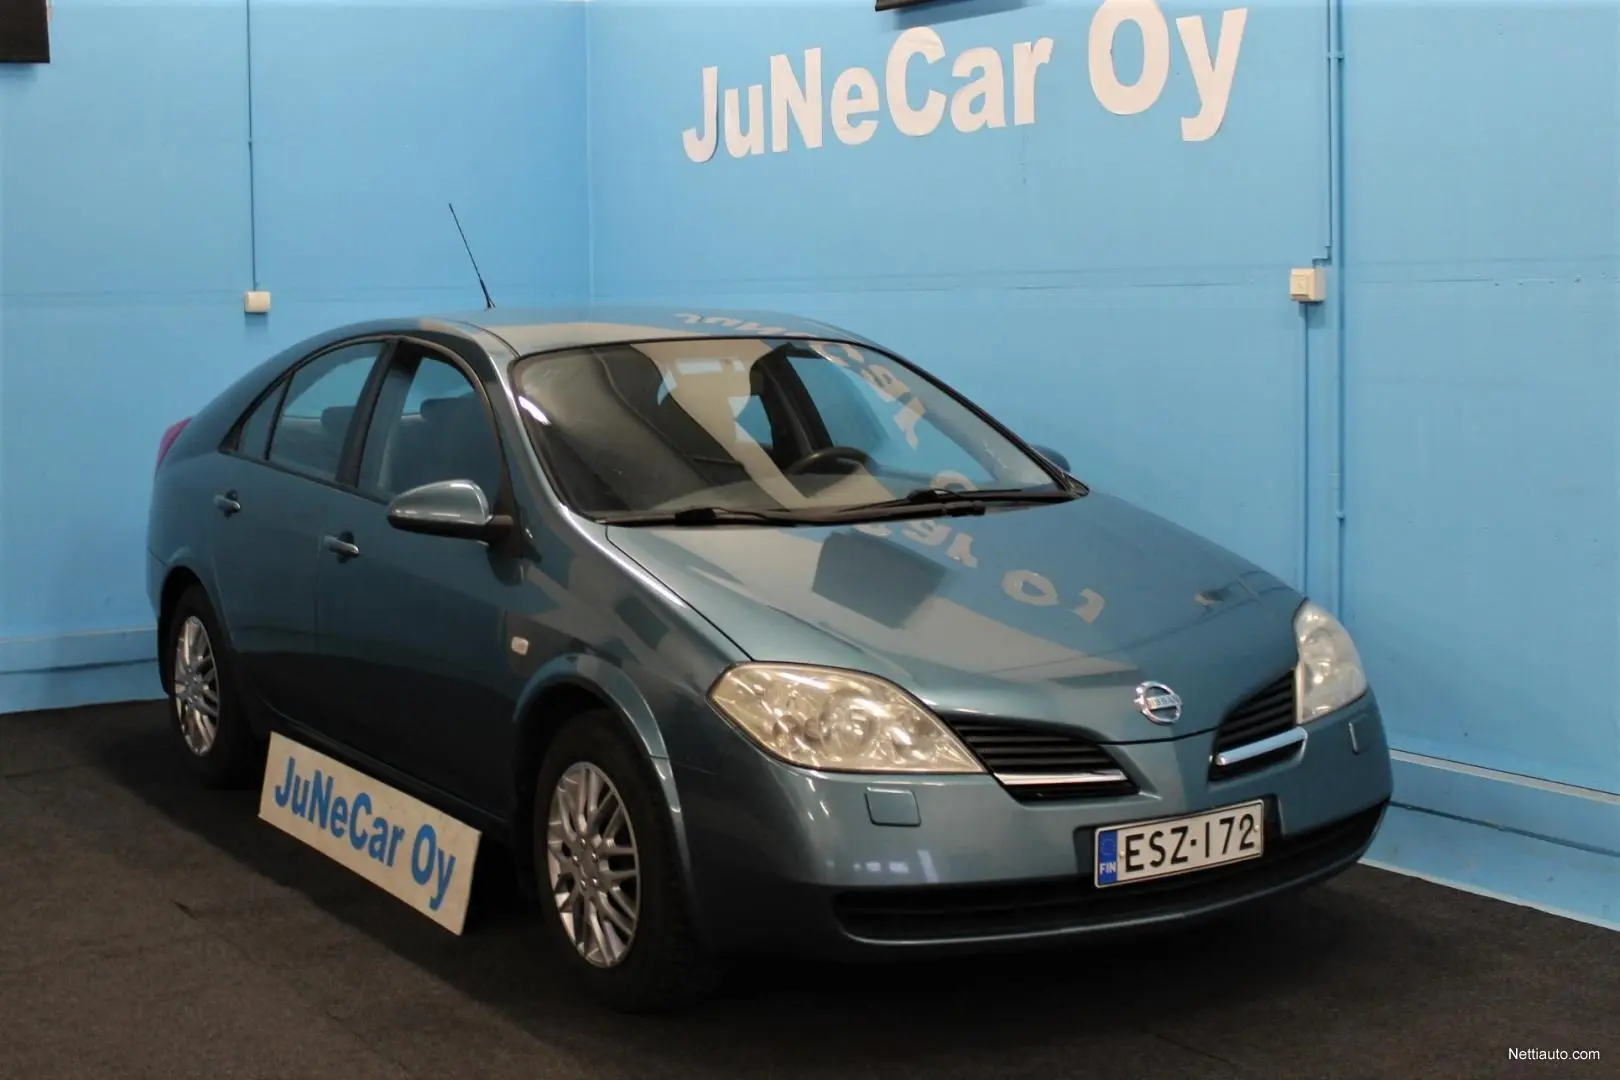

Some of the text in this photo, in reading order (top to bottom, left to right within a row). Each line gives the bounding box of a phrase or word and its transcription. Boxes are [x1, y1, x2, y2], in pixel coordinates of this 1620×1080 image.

[682, 0, 1248, 163] JuNeCar Oy
[274, 756, 456, 911] JuNeCar Oy
[1099, 861, 1117, 875] FIN
